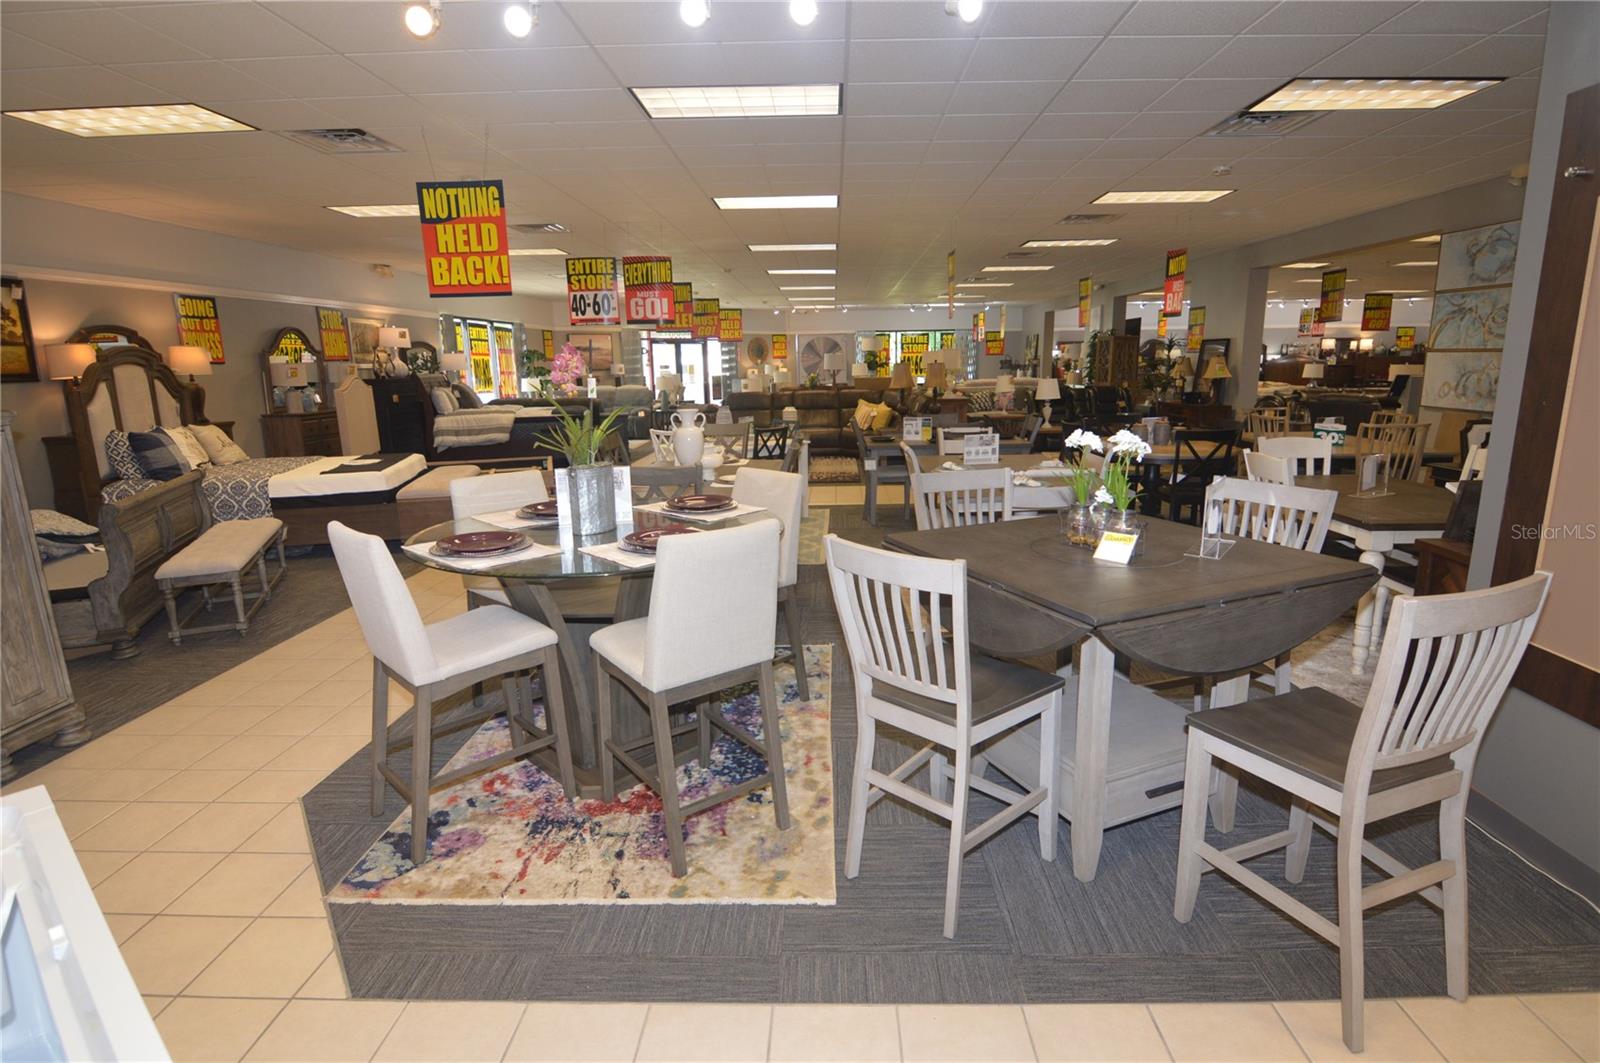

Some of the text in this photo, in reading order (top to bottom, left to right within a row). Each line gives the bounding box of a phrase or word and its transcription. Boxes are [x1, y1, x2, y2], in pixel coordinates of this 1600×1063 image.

[422, 186, 501, 219] NOTHING
[436, 222, 498, 253] HELD
[431, 255, 509, 286] BACK!
[568, 259, 614, 274] ENTIRE
[625, 261, 671, 286] EVERYTHING
[571, 275, 614, 290] STORE
[177, 298, 215, 317] GOING
[631, 298, 669, 319] GO!
[181, 318, 217, 331] OUT OF
[320, 310, 342, 330] STORE
